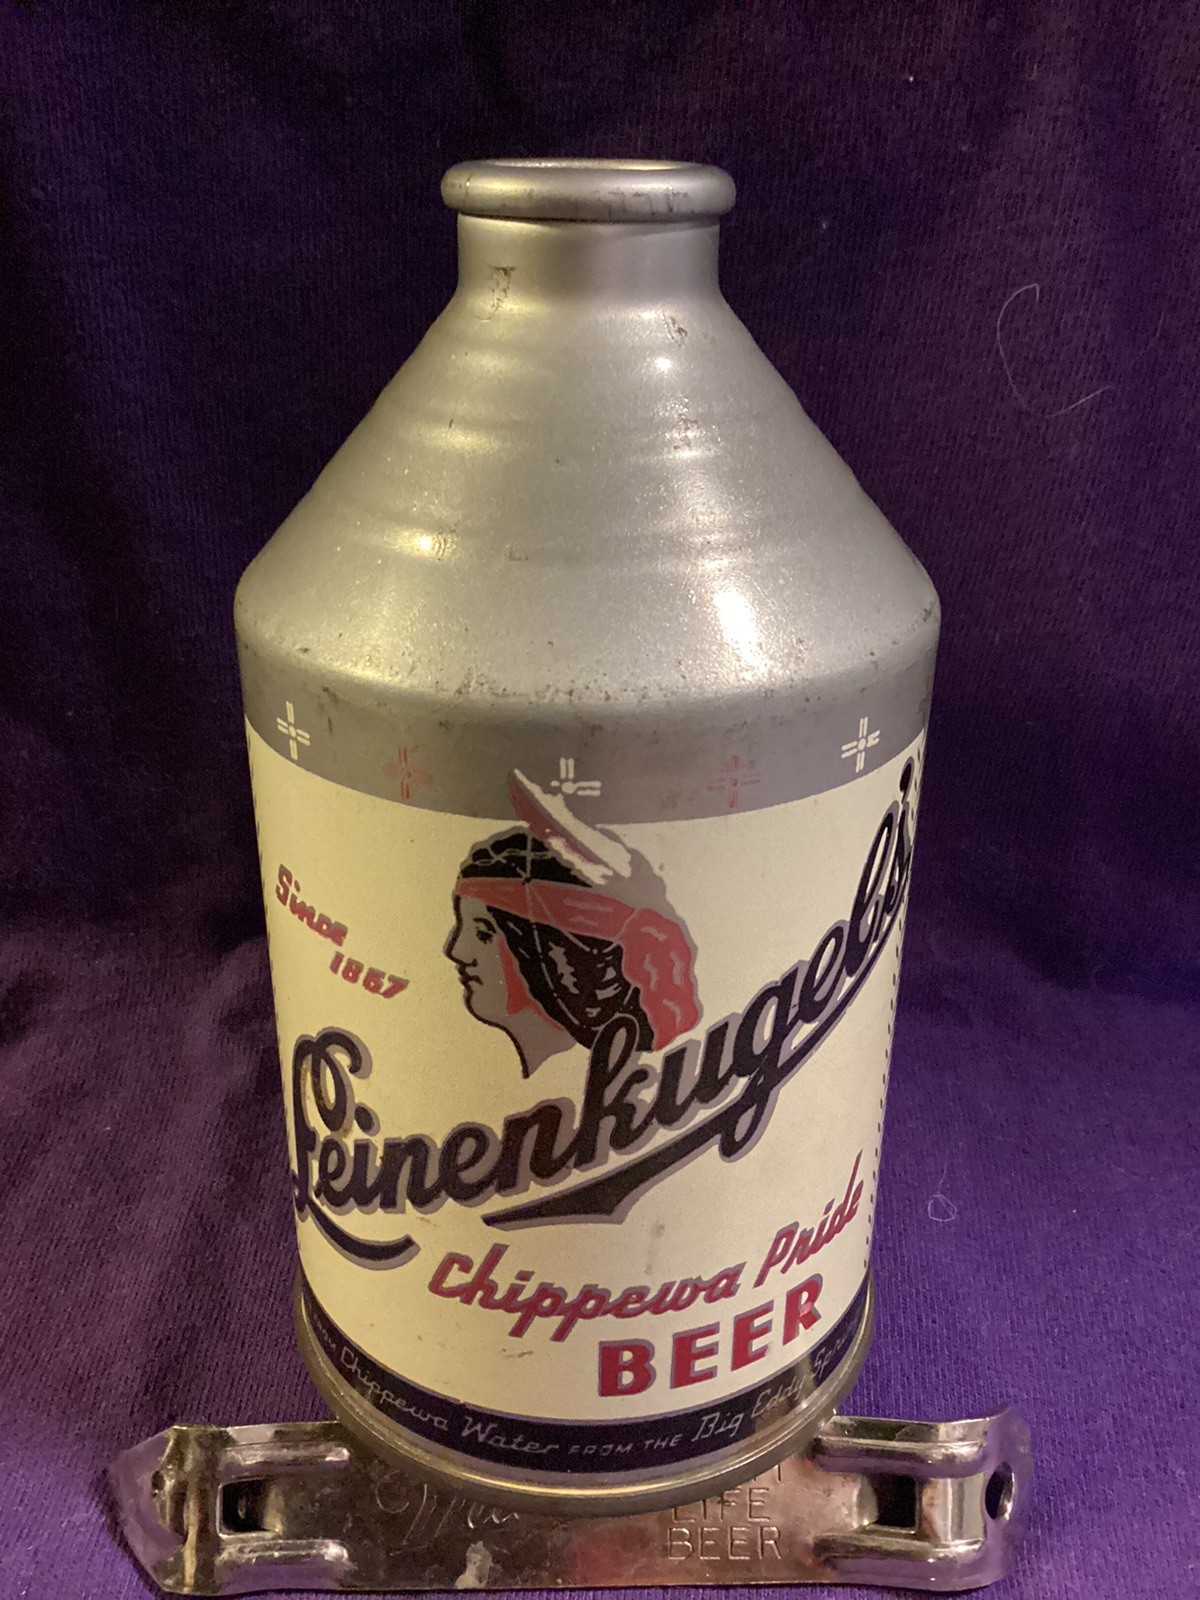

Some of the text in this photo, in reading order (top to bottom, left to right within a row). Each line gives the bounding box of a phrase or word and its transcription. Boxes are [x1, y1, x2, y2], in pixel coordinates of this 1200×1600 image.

[275, 864, 348, 947] Since
[753, 1149, 865, 1288] Pride
[598, 1273, 823, 1397] BEER
[340, 1346, 449, 1431] Chippewa
[461, 1415, 559, 1454] Water
[568, 1443, 633, 1456] FROM
[644, 1433, 682, 1449] THE
[691, 1412, 745, 1442] Big
[751, 1375, 806, 1418] Eddy
[667, 1526, 782, 1560] BEER
